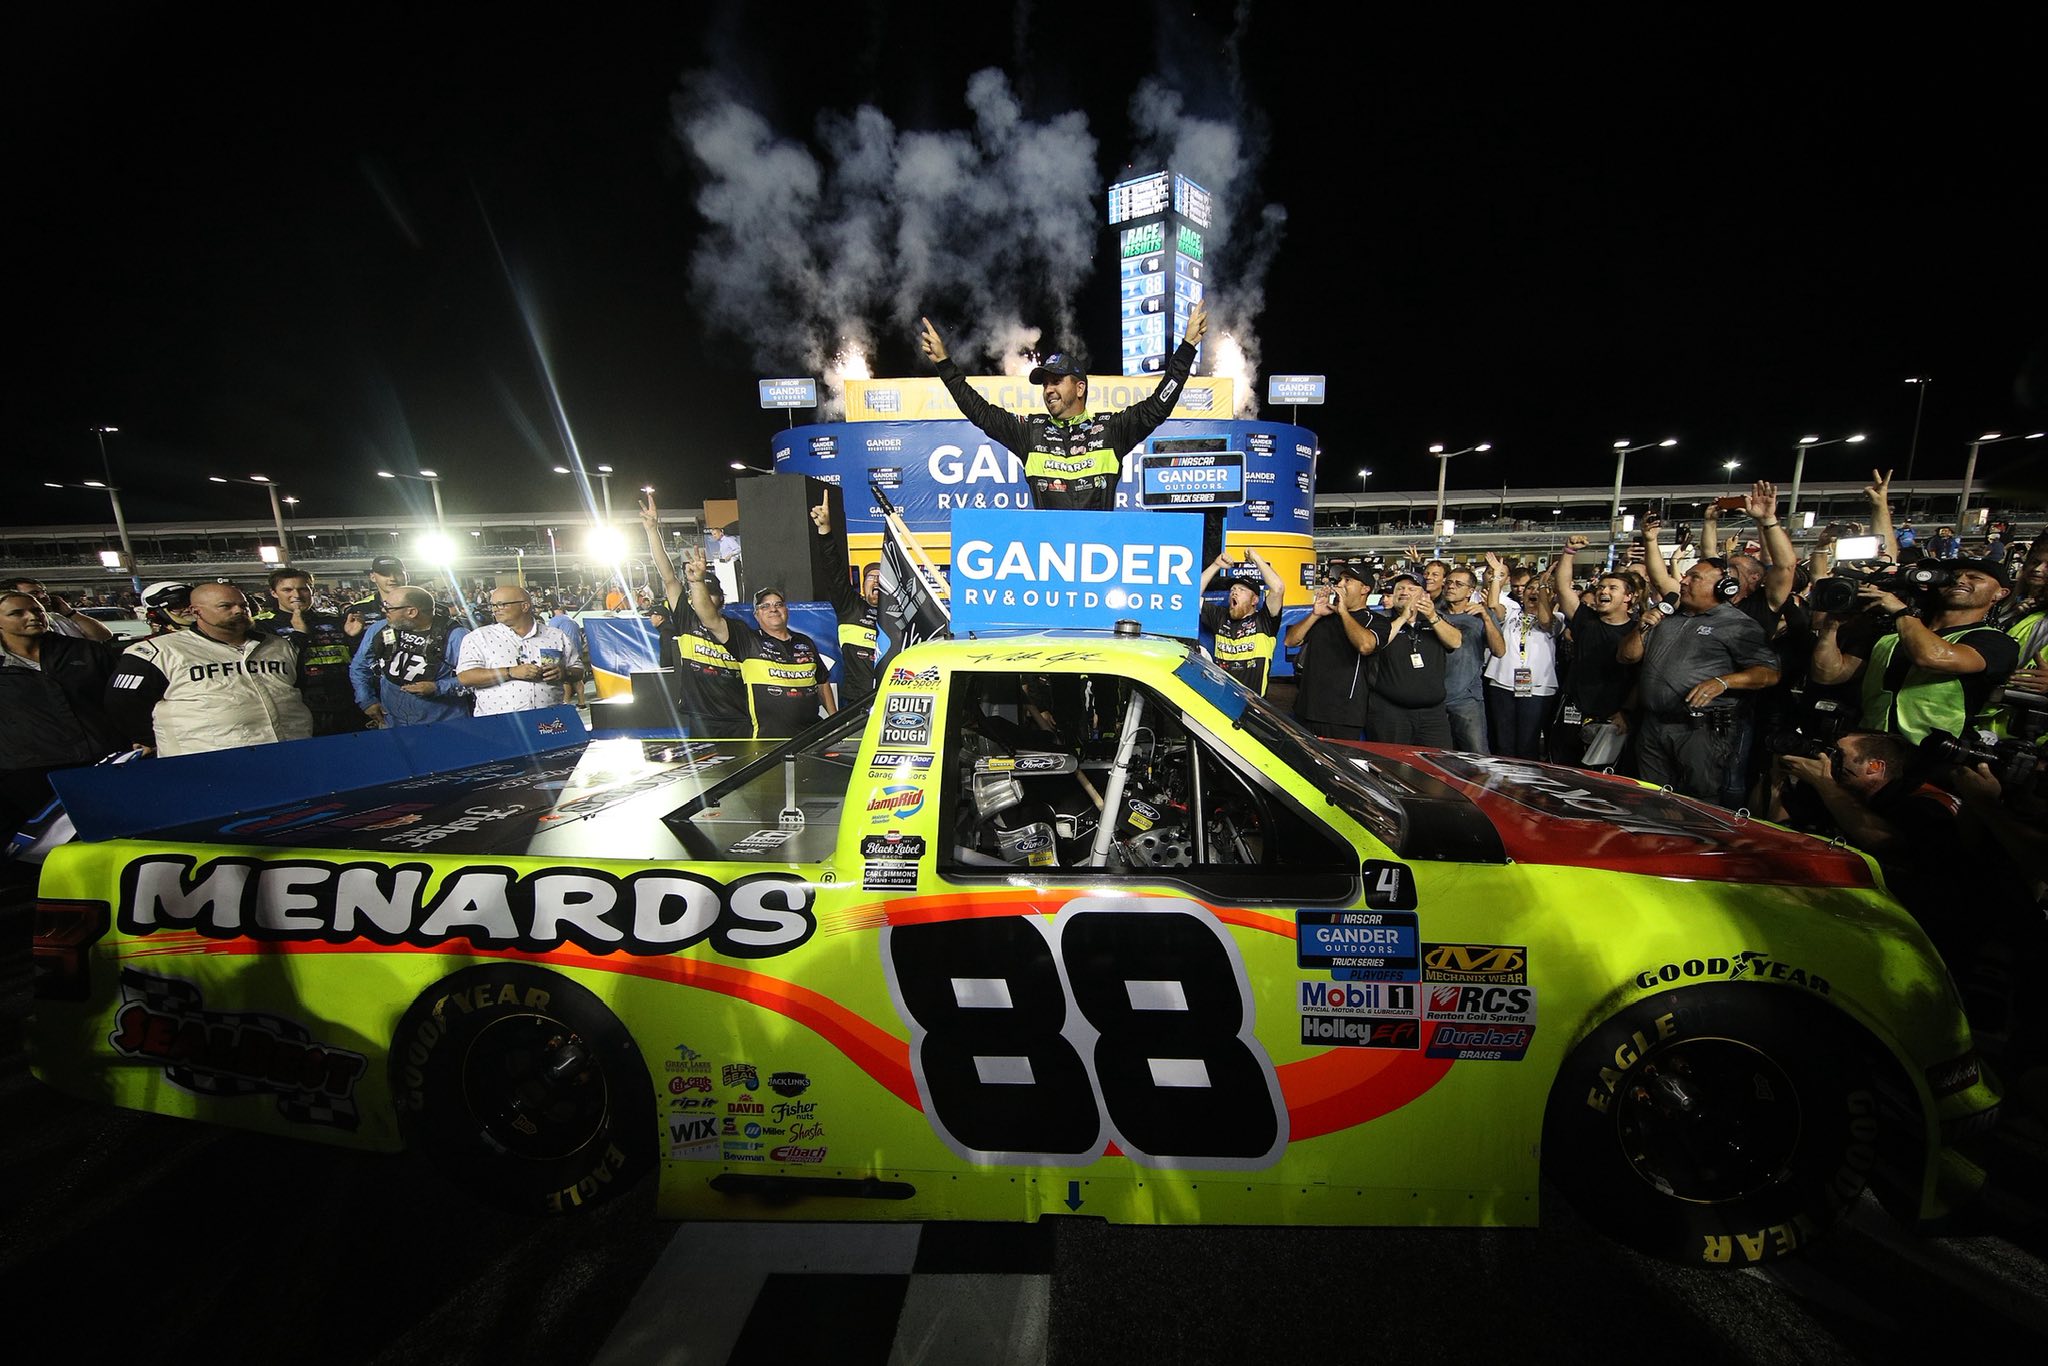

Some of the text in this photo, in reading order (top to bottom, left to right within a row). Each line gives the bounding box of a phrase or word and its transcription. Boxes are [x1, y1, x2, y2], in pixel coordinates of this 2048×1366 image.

[1127, 223, 1160, 245] RACE
[1181, 225, 1201, 249] RACE
[1123, 238, 1162, 257] RESULTS
[1178, 240, 1203, 261] RESULTS
[769, 387, 807, 396] GANDER
[1278, 383, 1316, 391] GANDER
[867, 439, 901, 447] GANDER
[1296, 443, 1312, 455] GANDER
[776, 448, 791, 459] GANDER
[1044, 459, 1095, 473] MENARDS
[1181, 457, 1215, 466] NASCAR
[813, 475, 841, 483] ANDER
[1158, 469, 1228, 483] GANDER
[1245, 472, 1275, 480] GANDER
[1170, 493, 1215, 503] TRUCK SERIES
[869, 506, 904, 514] GAER
[1293, 508, 1310, 516] GANDER
[956, 540, 1193, 587] GANDER
[189, 661, 289, 682] OFFICIAL
[889, 698, 931, 713] BUILT
[896, 716, 917, 725] Ford
[885, 729, 927, 742] TOUGH
[1021, 760, 1053, 769] Ford
[868, 771, 894, 780] Garag
[866, 789, 924, 812] DampRid
[1133, 803, 1155, 818] Ford
[865, 842, 920, 855] Black Label
[1022, 838, 1044, 850] Ford
[883, 870, 917, 878] SIMMONS
[1375, 868, 1400, 903] 4
[124, 859, 815, 954] MENARDS
[1343, 914, 1382, 925] NASCAR
[1316, 928, 1399, 944] GANDER
[1332, 957, 1384, 967] TRUCK SERIES
[1350, 971, 1404, 980] PLAYOFFS
[1426, 970, 1524, 983] MECHANIX WEAR
[1302, 982, 1379, 1009] Mobil
[1457, 986, 1531, 1014] RCS
[1427, 1012, 1526, 1022] Renton Coil Spring
[884, 903, 1285, 1165] 88
[1303, 1018, 1371, 1045] Holley
[1437, 1026, 1525, 1047] Duralast
[1459, 1050, 1502, 1060] BRAKES
[665, 1060, 711, 1068] GREAT LAKES
[722, 1064, 757, 1075] FLEX
[1585, 1012, 1680, 1114] EAGLE
[723, 1073, 755, 1086] SEAL
[768, 1078, 788, 1087] JACK
[727, 1103, 764, 1114] DAVID
[770, 1100, 818, 1123] Fisher
[670, 1117, 718, 1144] WIX
[762, 1127, 786, 1136] Miller
[789, 1122, 825, 1143] Shasta
[770, 1145, 828, 1162] Eibach
